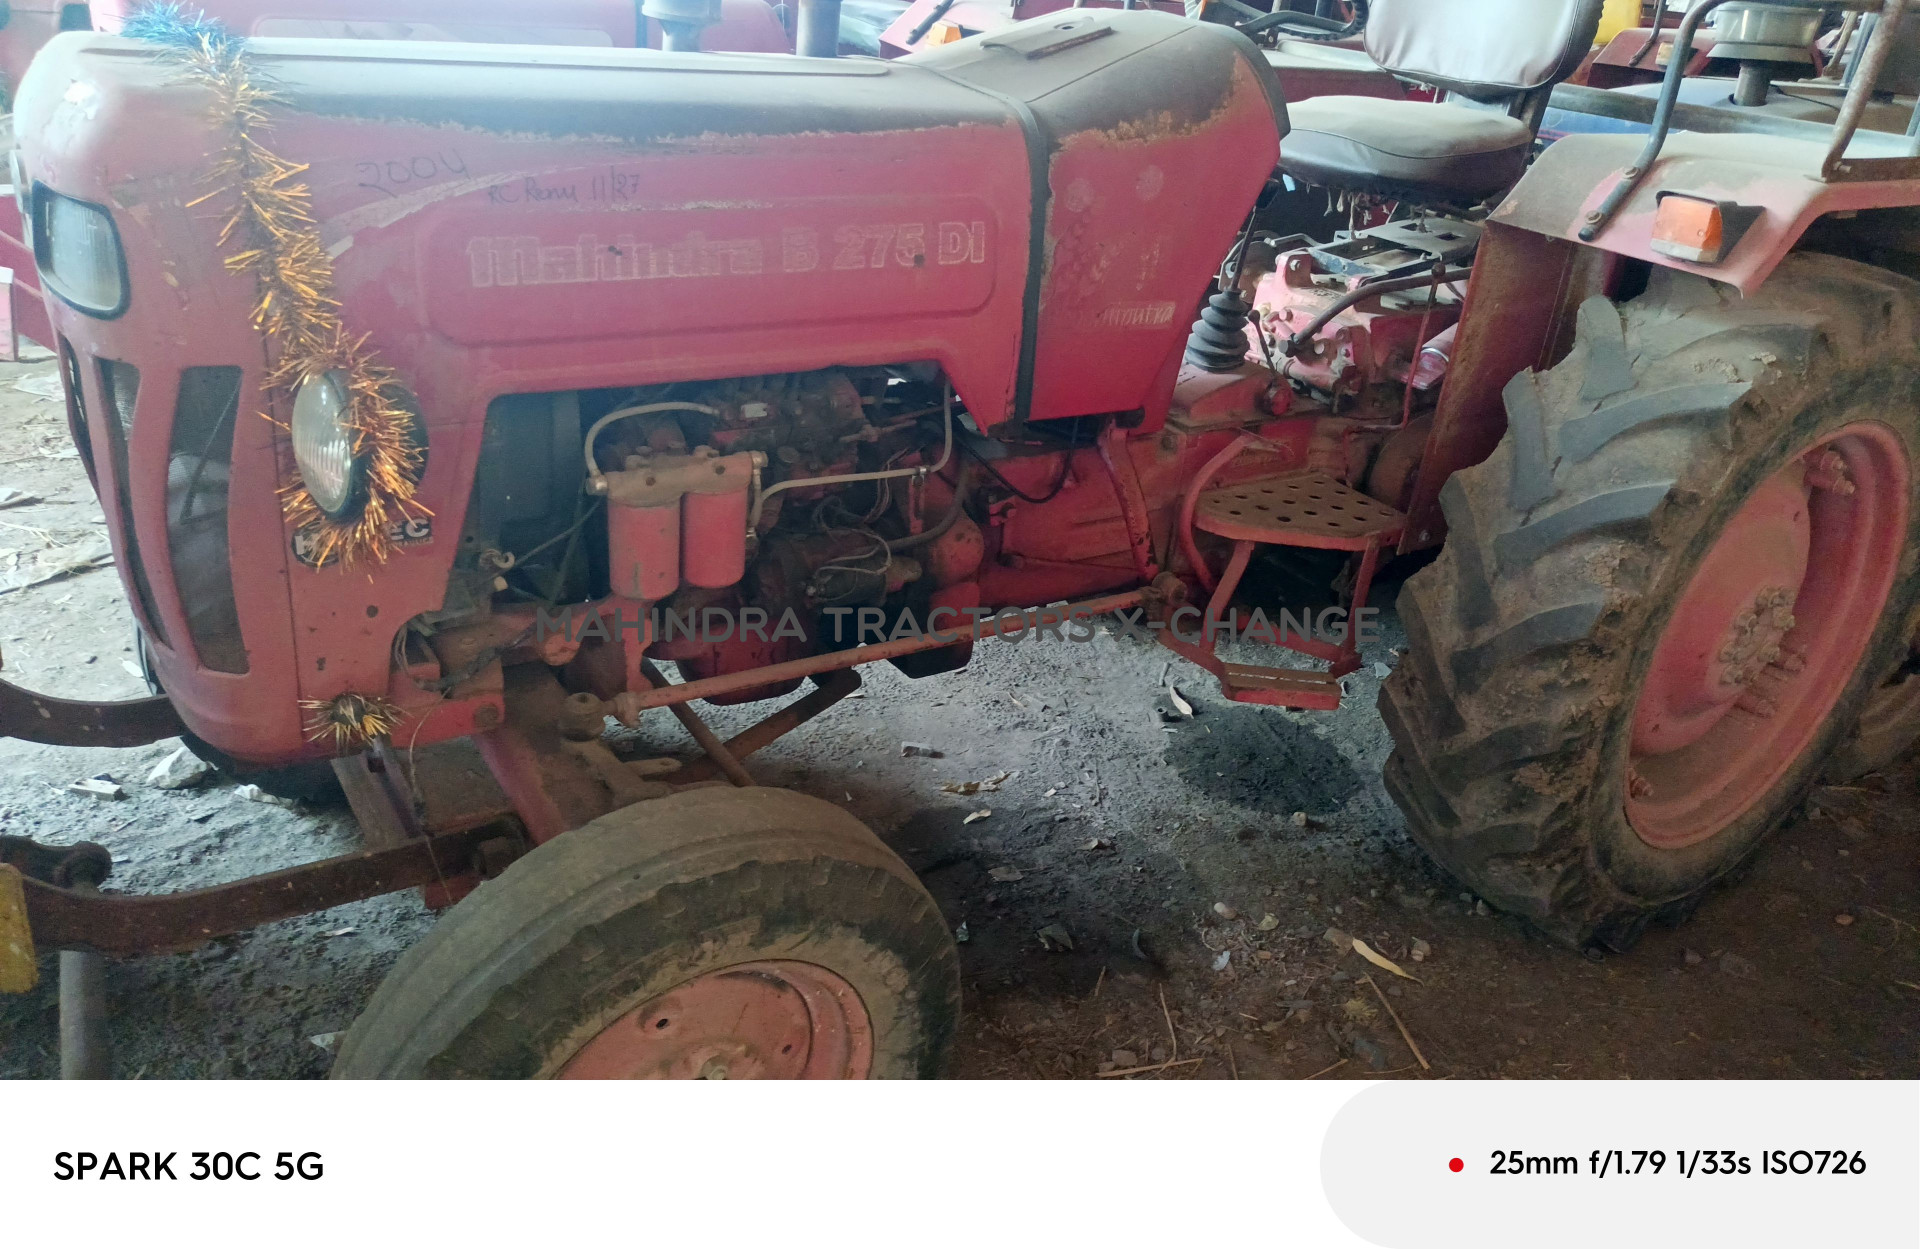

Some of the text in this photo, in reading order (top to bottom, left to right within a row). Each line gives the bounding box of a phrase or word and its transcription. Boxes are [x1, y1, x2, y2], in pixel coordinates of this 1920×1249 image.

[355, 147, 472, 198] 2004
[467, 221, 986, 289] Mahindra B 275 DI
